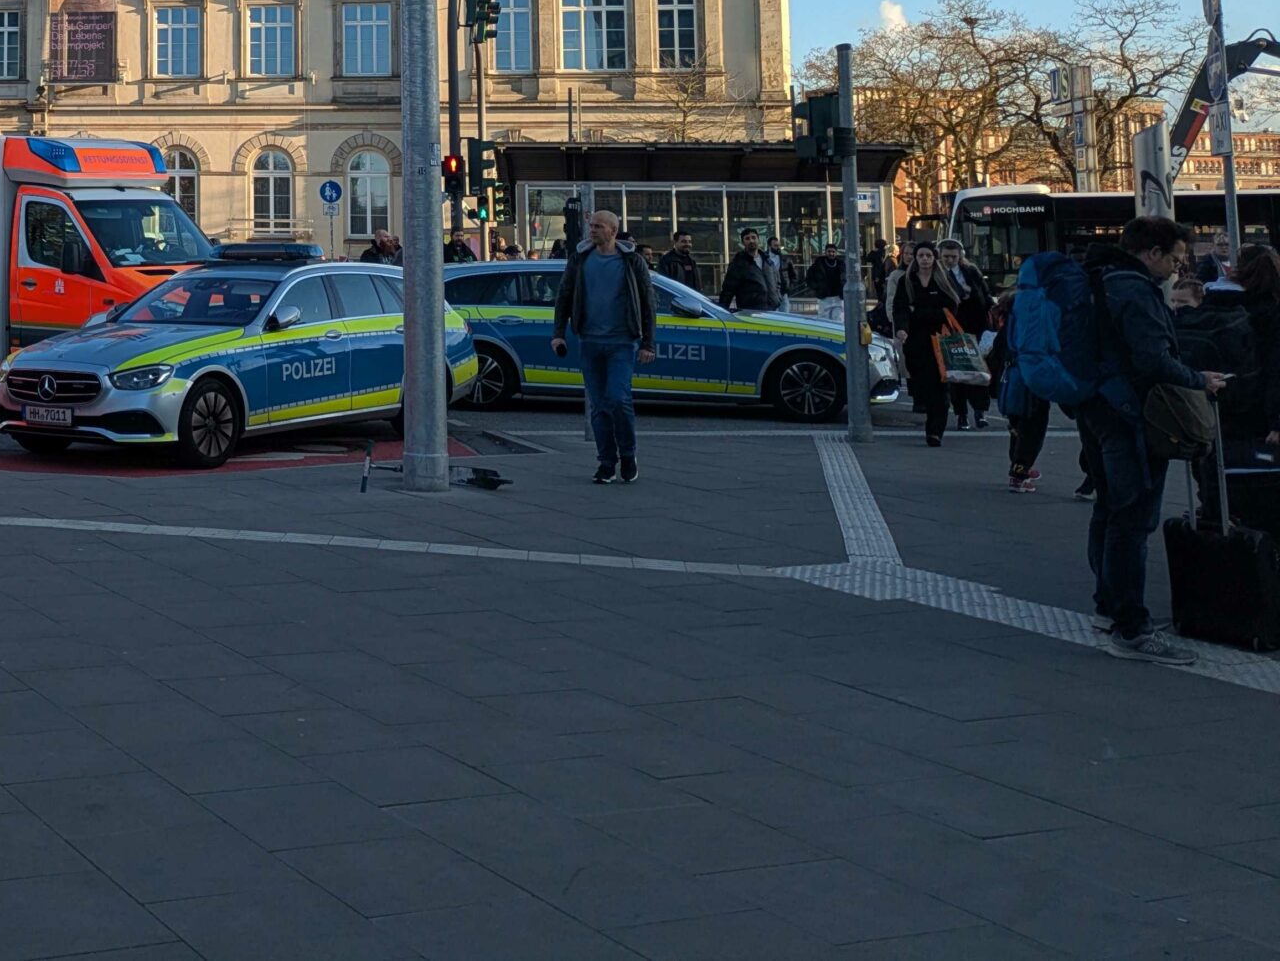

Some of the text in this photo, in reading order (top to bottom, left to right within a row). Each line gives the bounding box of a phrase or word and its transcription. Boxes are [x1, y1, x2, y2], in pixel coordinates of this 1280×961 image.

[992, 206, 1045, 214] HOCHBAHN
[634, 342, 706, 361] LIZEI
[282, 357, 336, 381] POLIZEI
[29, 407, 67, 422] HH 7011
